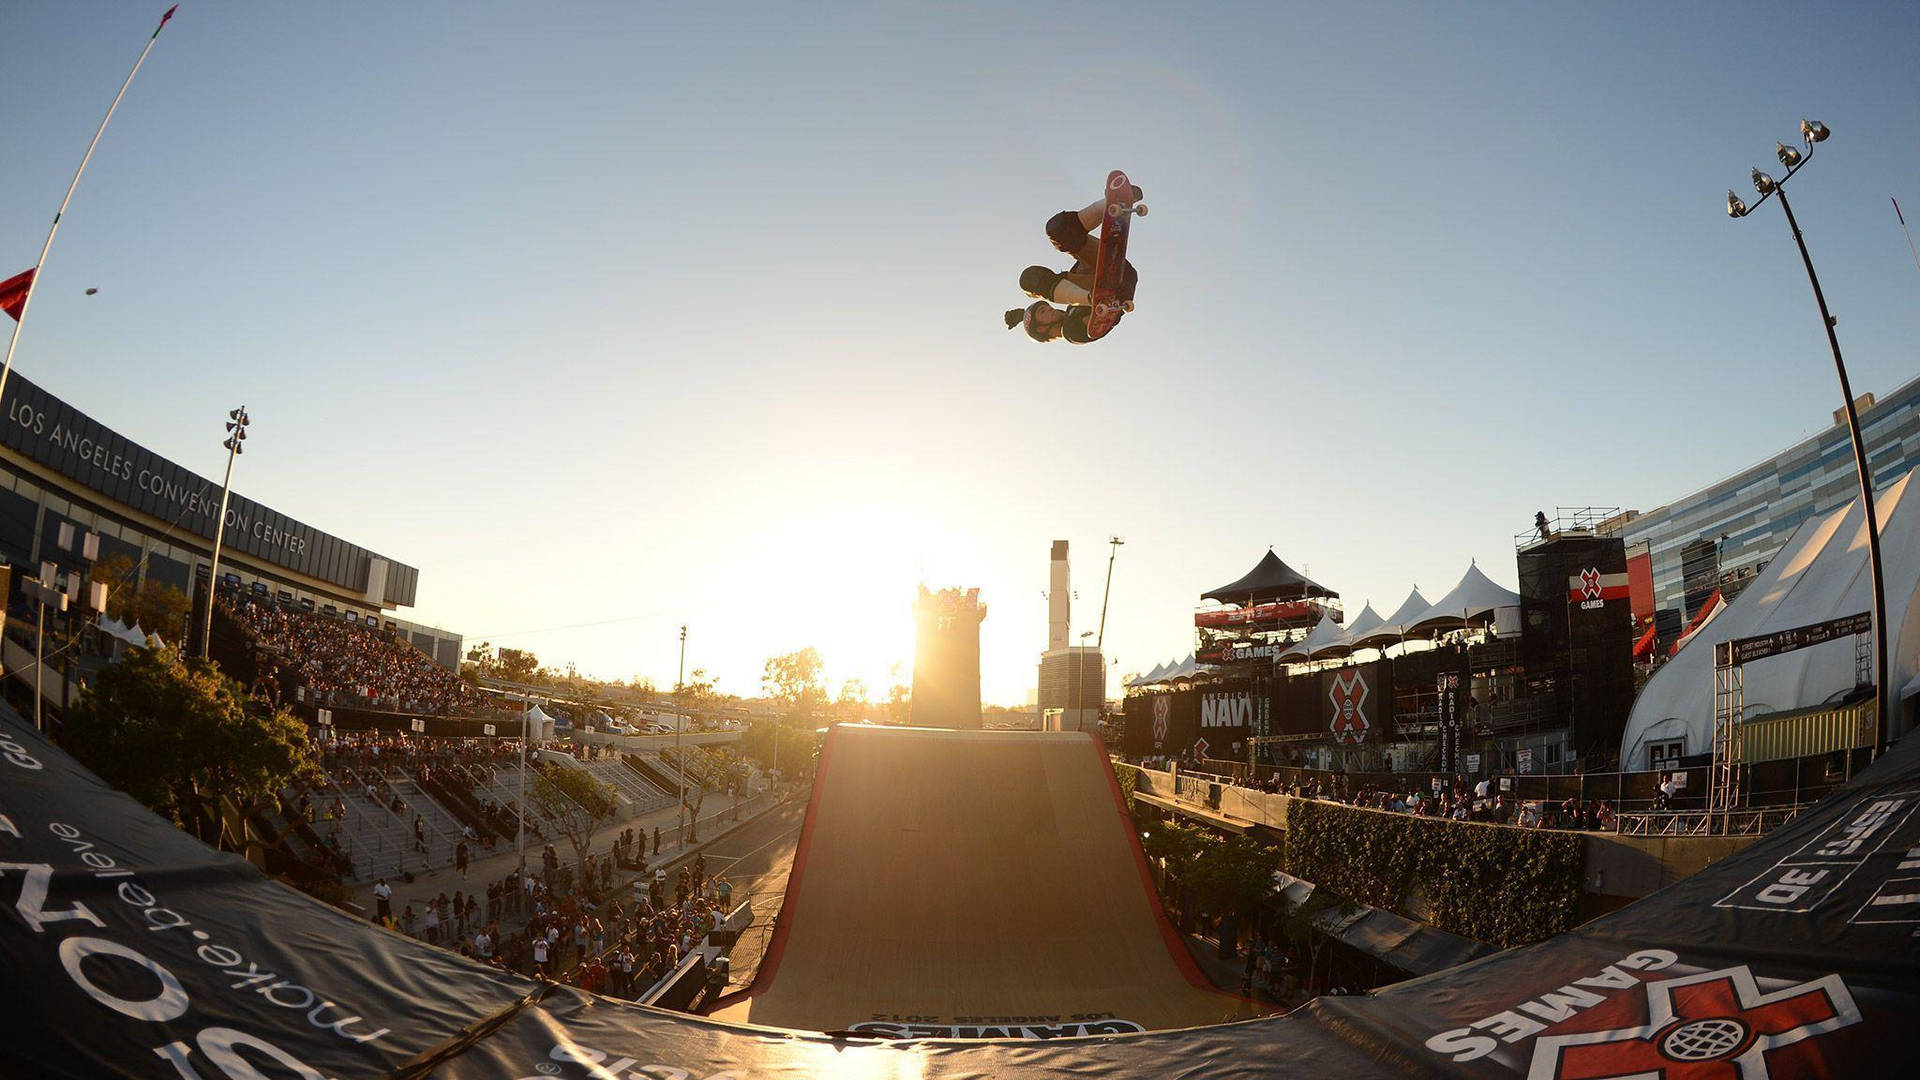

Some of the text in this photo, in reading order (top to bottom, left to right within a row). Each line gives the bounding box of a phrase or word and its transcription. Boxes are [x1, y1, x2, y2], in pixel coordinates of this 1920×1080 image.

[9, 398, 305, 556] LOS ANGELES CONVENTON CENTER
[1581, 599, 1604, 609] GAMES
[1235, 645, 1280, 659] GAMES
[1755, 868, 1830, 904] 3D
[871, 1012, 1116, 1024] LOS ANGELES 2012
[1425, 949, 1679, 1063] GAMES
